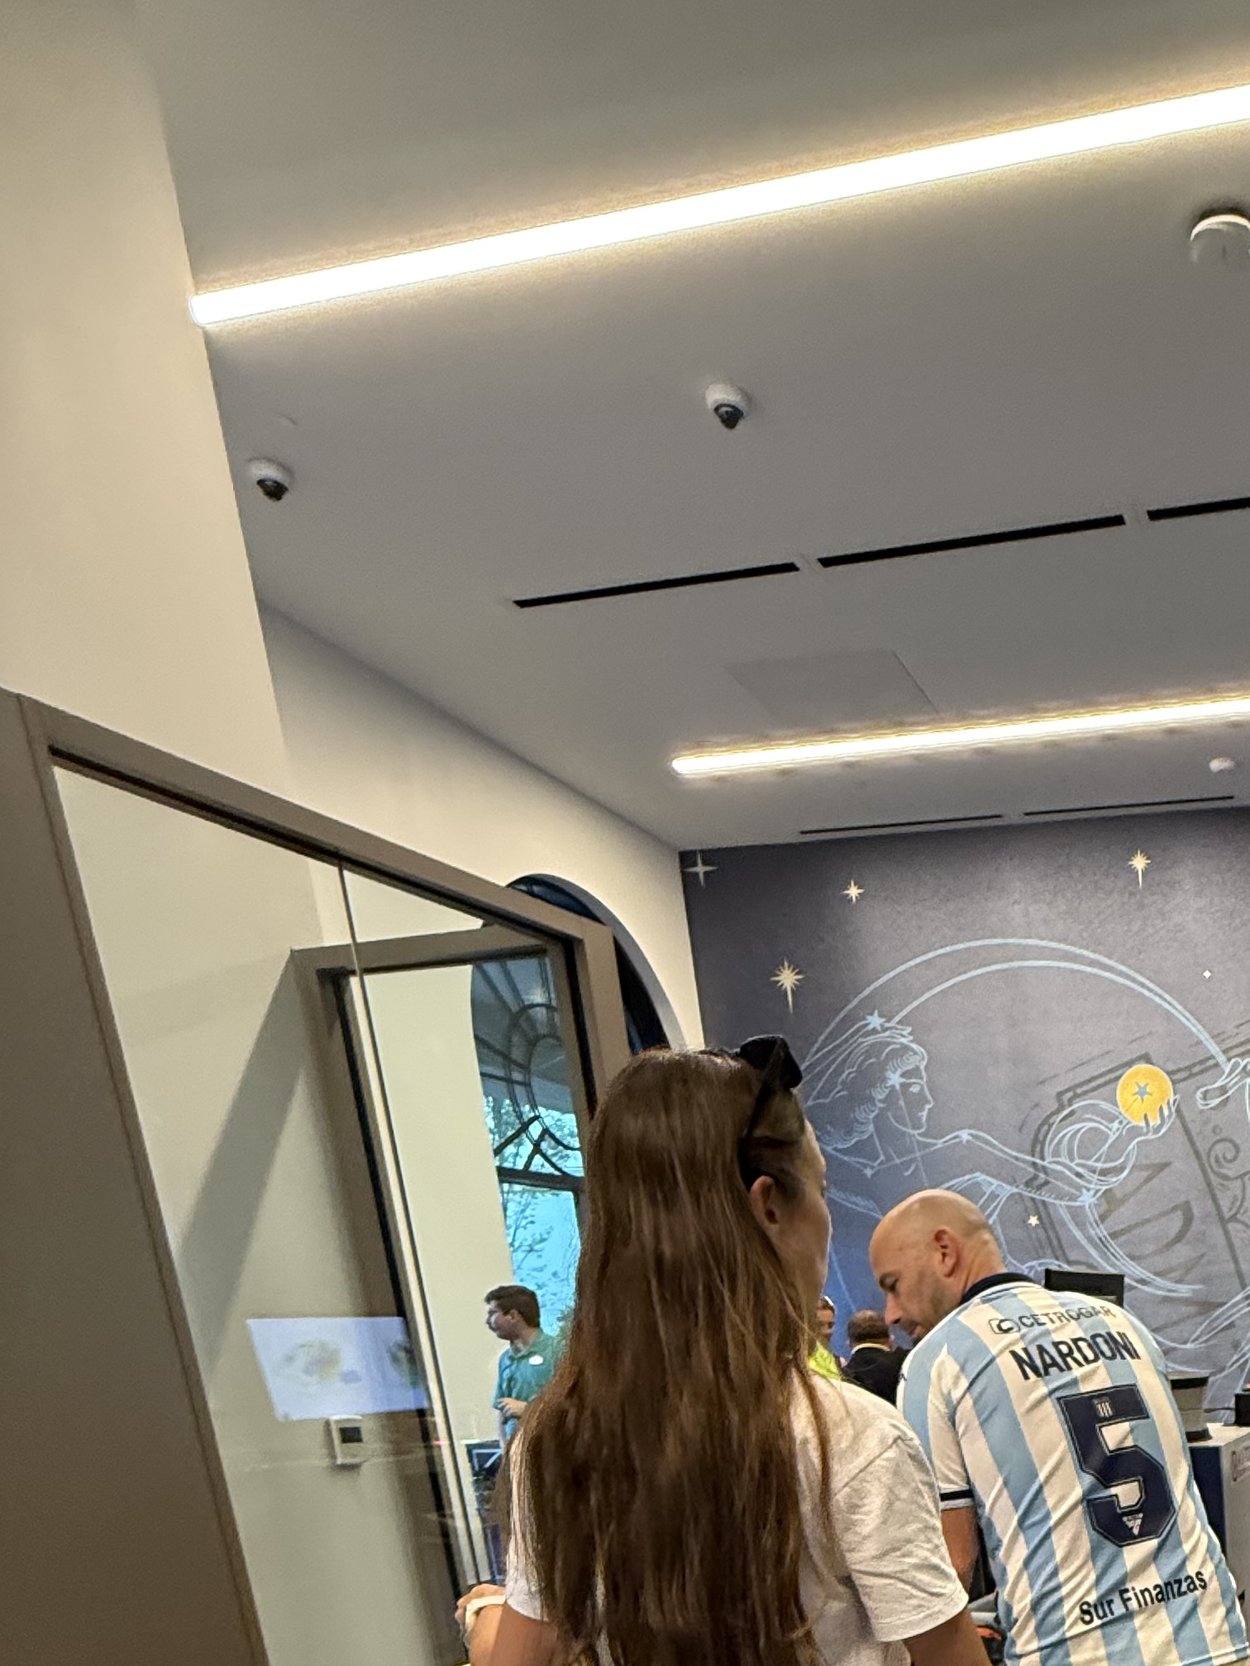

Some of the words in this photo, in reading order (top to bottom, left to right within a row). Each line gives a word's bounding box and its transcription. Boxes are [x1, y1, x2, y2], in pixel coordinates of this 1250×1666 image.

[1018, 1305, 1117, 1328] CETROGAR
[1008, 1330, 1142, 1381] NARDONI
[1056, 1384, 1177, 1548] 5
[1078, 1598, 1115, 1626] Sur
[1118, 1570, 1208, 1612] Finanzas
